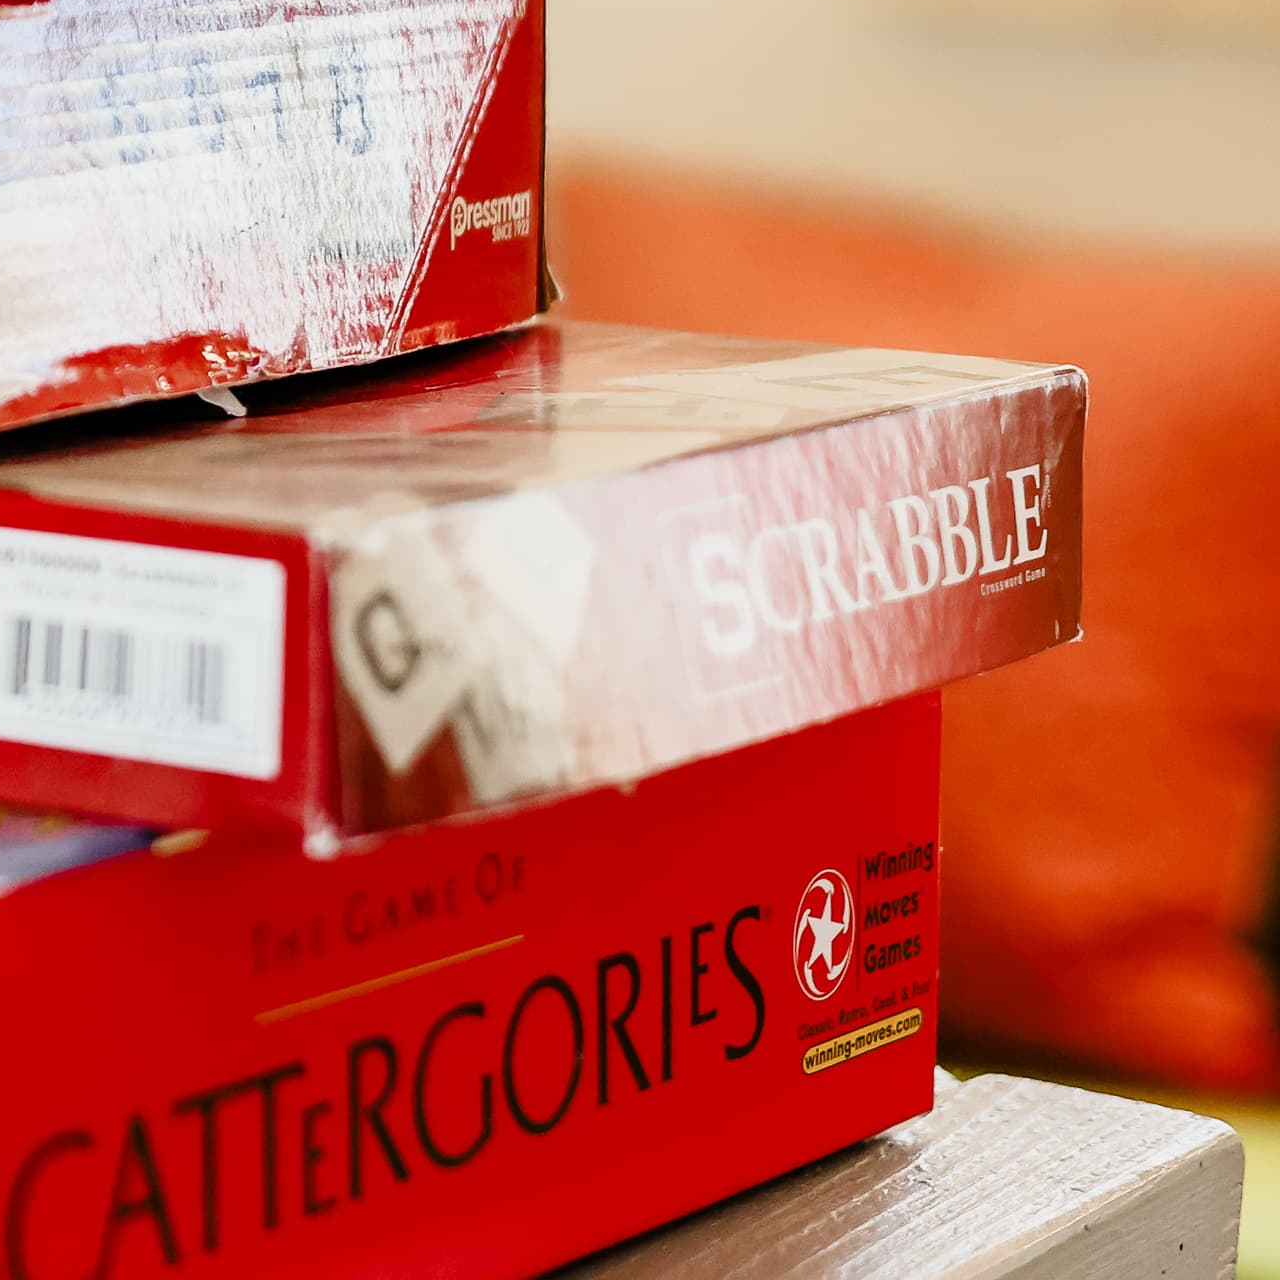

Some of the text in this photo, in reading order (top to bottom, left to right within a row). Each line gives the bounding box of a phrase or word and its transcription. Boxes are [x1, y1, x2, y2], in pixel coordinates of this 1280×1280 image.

[690, 464, 1050, 657] SCRABBLE
[980, 566, 1046, 596] Crossword Game
[864, 841, 935, 881] Winning
[864, 891, 920, 930] Moves
[864, 935, 921, 974] Games
[804, 1012, 921, 1060] winning-moves.com
